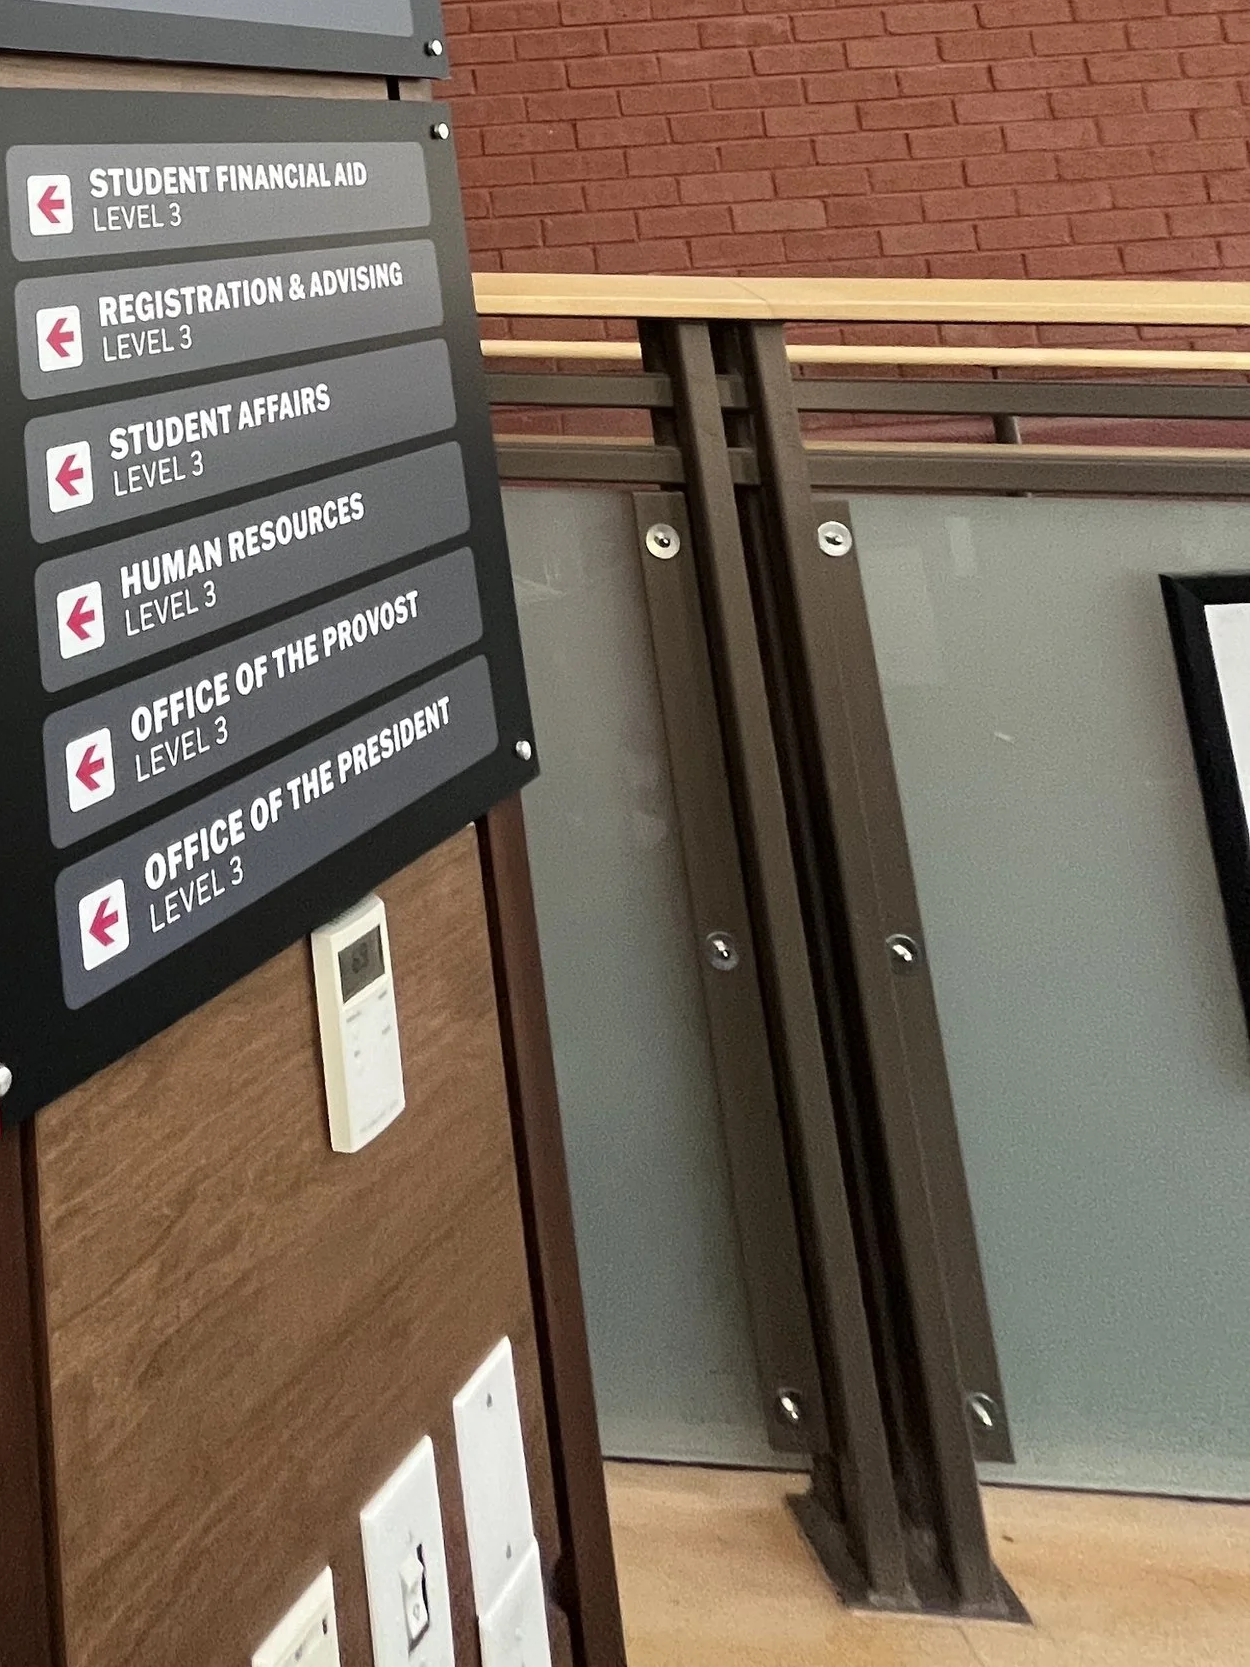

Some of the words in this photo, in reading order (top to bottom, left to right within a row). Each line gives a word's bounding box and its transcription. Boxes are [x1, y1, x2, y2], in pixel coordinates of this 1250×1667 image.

[89, 165, 211, 199] STUDENT
[215, 162, 332, 192] FINANCIAL
[334, 161, 367, 187] AID
[93, 204, 165, 232] LEVEL
[168, 202, 182, 227] 3
[98, 275, 284, 327] REGISTRATION
[288, 273, 306, 301] &
[309, 261, 404, 298] ADVISING
[102, 327, 175, 362] LEVEL
[178, 324, 193, 350] 3
[109, 403, 233, 461] STUDENT
[237, 383, 331, 431] AFFAIRS
[113, 455, 187, 497] LEVEL
[190, 450, 204, 477] 3
[120, 536, 223, 600] HUMAN
[227, 491, 365, 563] RESOURCES
[124, 588, 200, 637] LEVEL
[203, 579, 217, 608] 3
[130, 671, 231, 742] OFFICE
[235, 654, 268, 696] OF
[271, 633, 320, 679] THE
[322, 589, 419, 658] PROVOST
[135, 726, 211, 783] LEVEL
[214, 715, 229, 745] 3
[144, 807, 246, 891] OFFICE
[250, 786, 283, 832] OF
[286, 759, 335, 811] THE
[337, 695, 451, 785] PRESIDENT
[149, 868, 226, 934] LEVEL
[229, 854, 244, 886] 3
